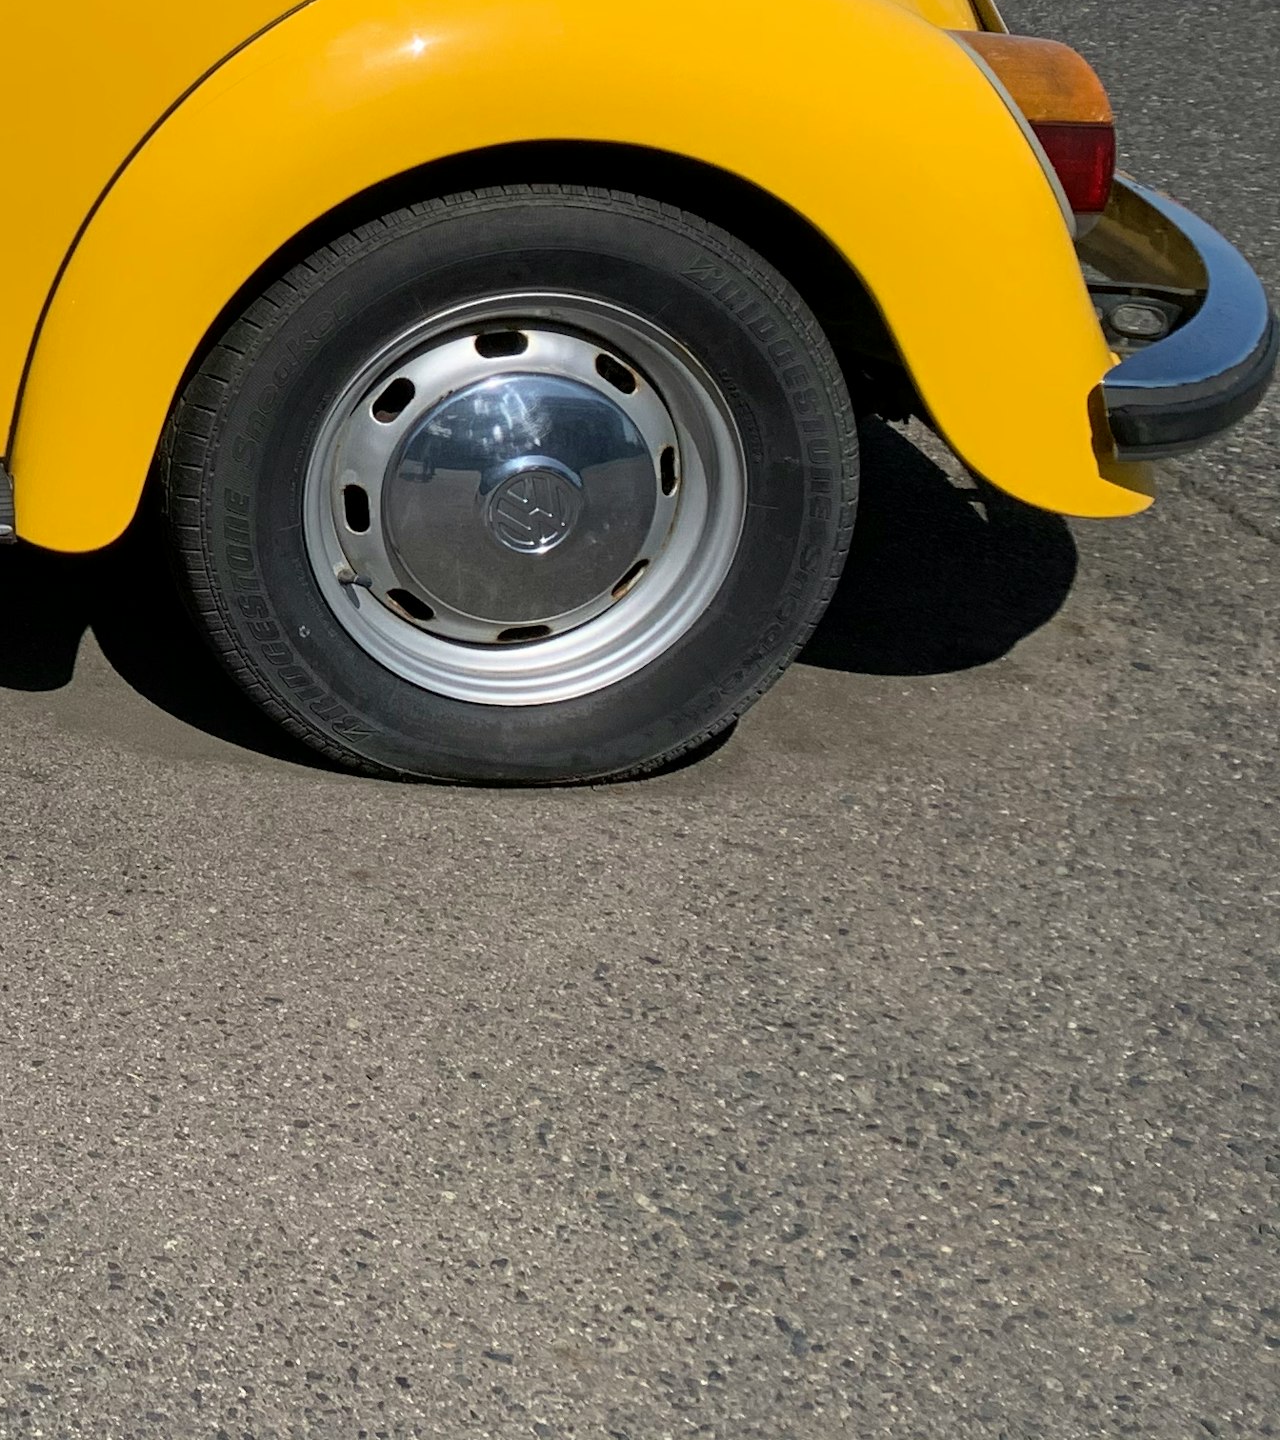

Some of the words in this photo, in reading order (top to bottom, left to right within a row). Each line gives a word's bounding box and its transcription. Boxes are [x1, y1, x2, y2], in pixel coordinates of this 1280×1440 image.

[234, 289, 349, 463] Sneaker
[680, 260, 835, 519] BRIDGESTONE
[224, 486, 377, 743] BRIDGESTONE
